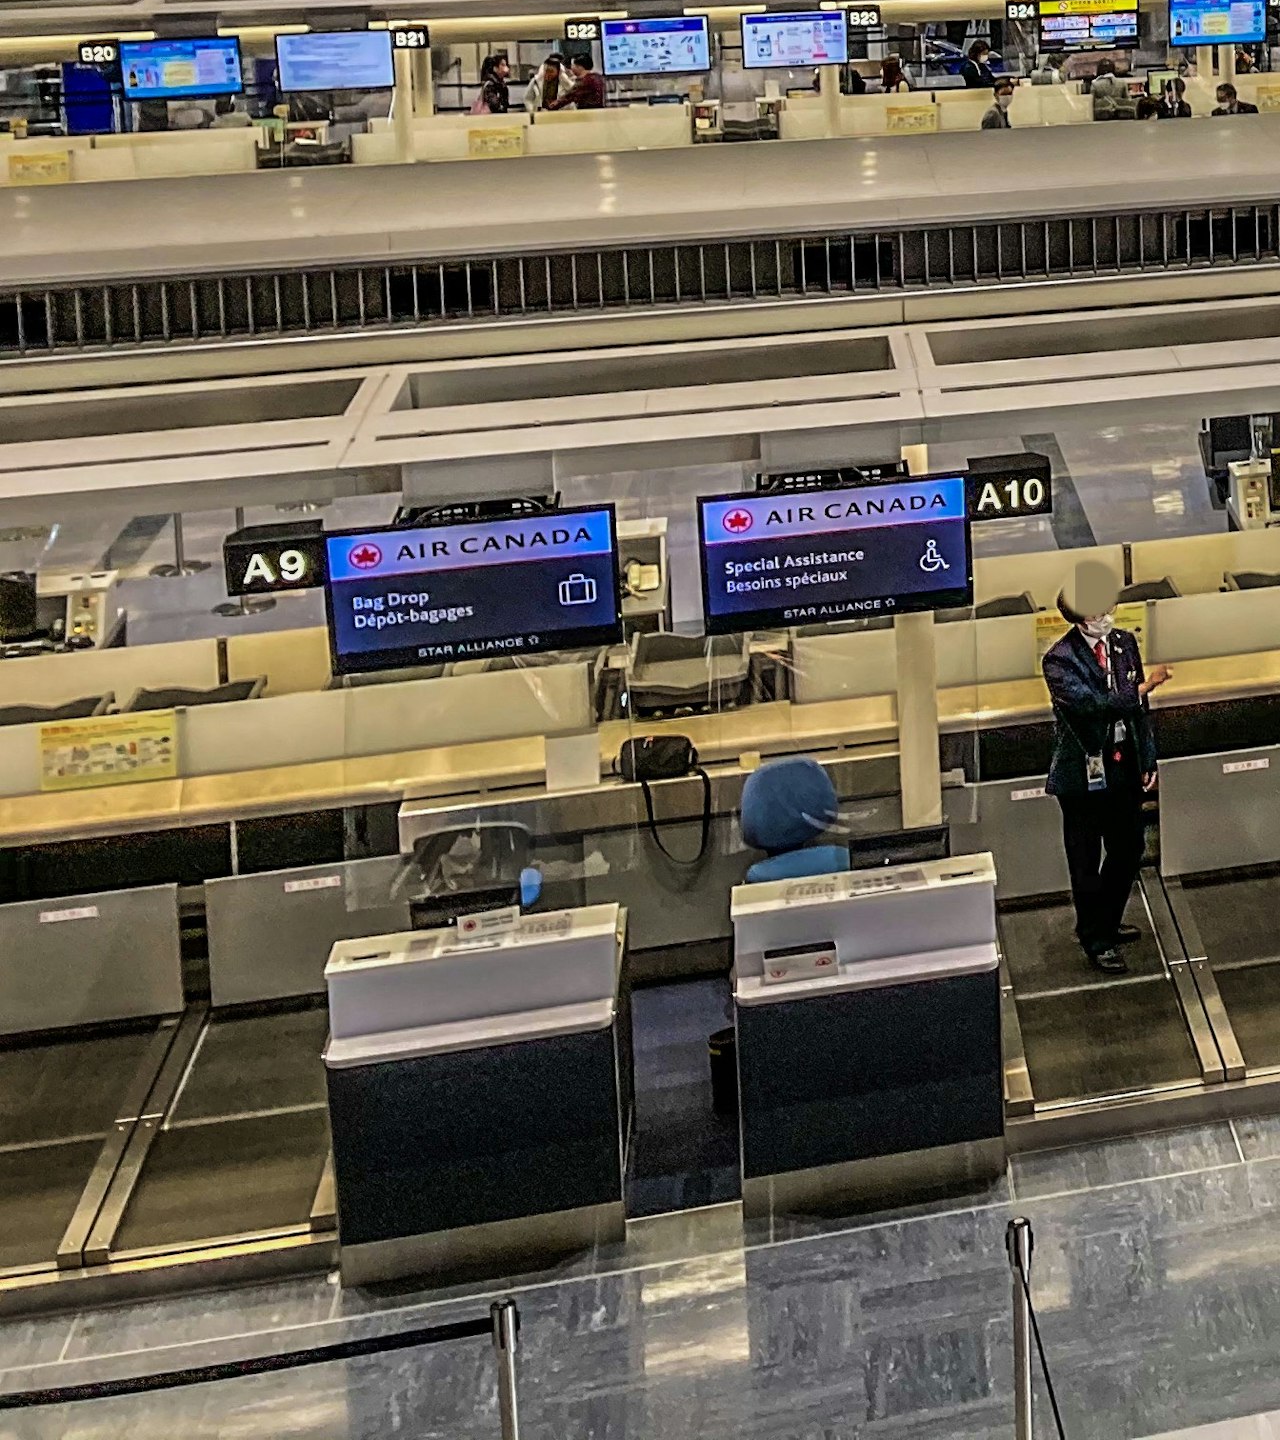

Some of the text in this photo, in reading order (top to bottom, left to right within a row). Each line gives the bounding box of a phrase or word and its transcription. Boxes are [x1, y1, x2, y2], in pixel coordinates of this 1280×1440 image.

[850, 12, 878, 26] B23
[1008, 4, 1036, 19] B24
[395, 32, 426, 47] B21
[567, 24, 597, 38] B22
[81, 46, 114, 62] B20
[977, 478, 1044, 512] A10
[765, 493, 947, 526] AIR CANADA
[396, 526, 593, 562] AIR CANADA
[243, 549, 306, 585] A9
[724, 548, 865, 577] Special Assistance
[726, 568, 848, 594] Besoins spéciaux
[352, 591, 430, 615] Bag Drop
[783, 598, 882, 619] STAR ALLIANCE
[353, 603, 474, 631] Dépôt-bagages
[418, 636, 525, 659] STAR ALLIANCE
